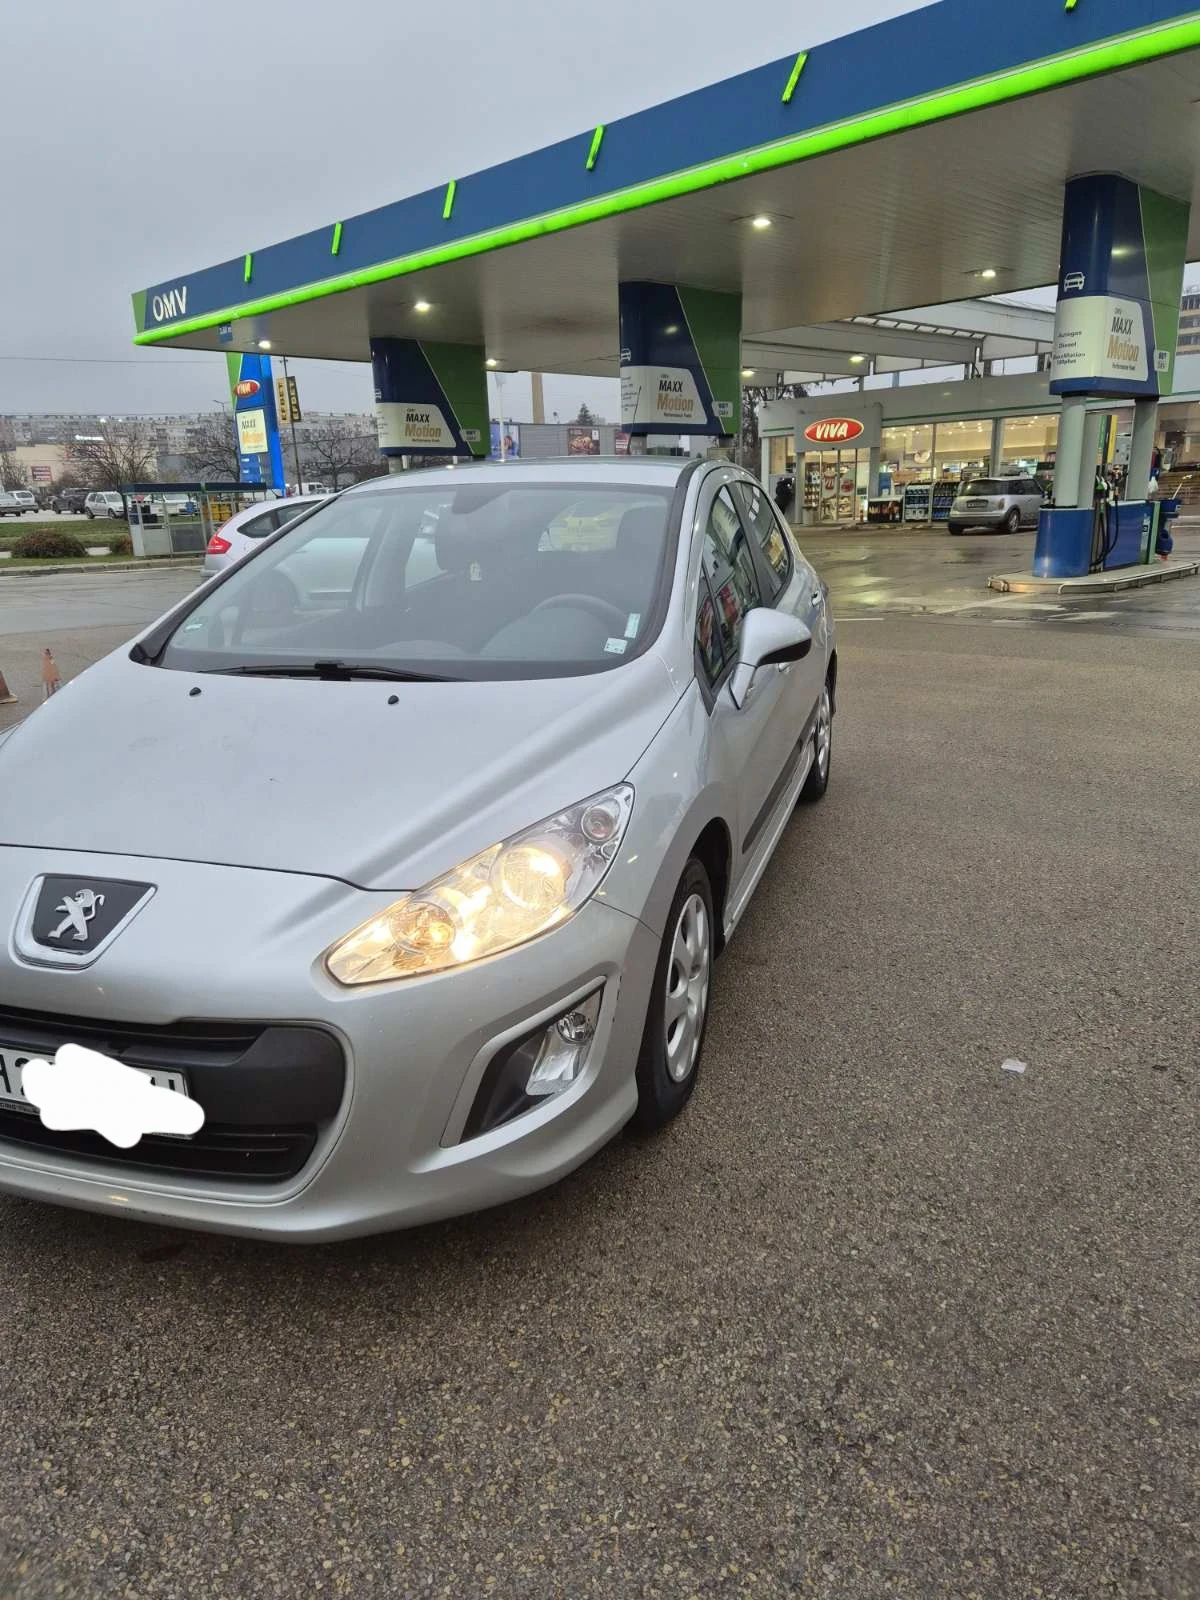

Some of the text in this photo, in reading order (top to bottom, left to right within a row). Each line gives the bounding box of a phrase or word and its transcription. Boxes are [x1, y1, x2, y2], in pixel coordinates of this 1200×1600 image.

[152, 286, 187, 322] OMV
[1111, 316, 1133, 335] MAXX
[1107, 334, 1140, 362] Motion
[659, 379, 683, 393] MAXX
[657, 393, 694, 412] Motion
[406, 413, 430, 423] MAXX
[405, 423, 442, 437] Motion
[815, 422, 849, 439] VIVA
